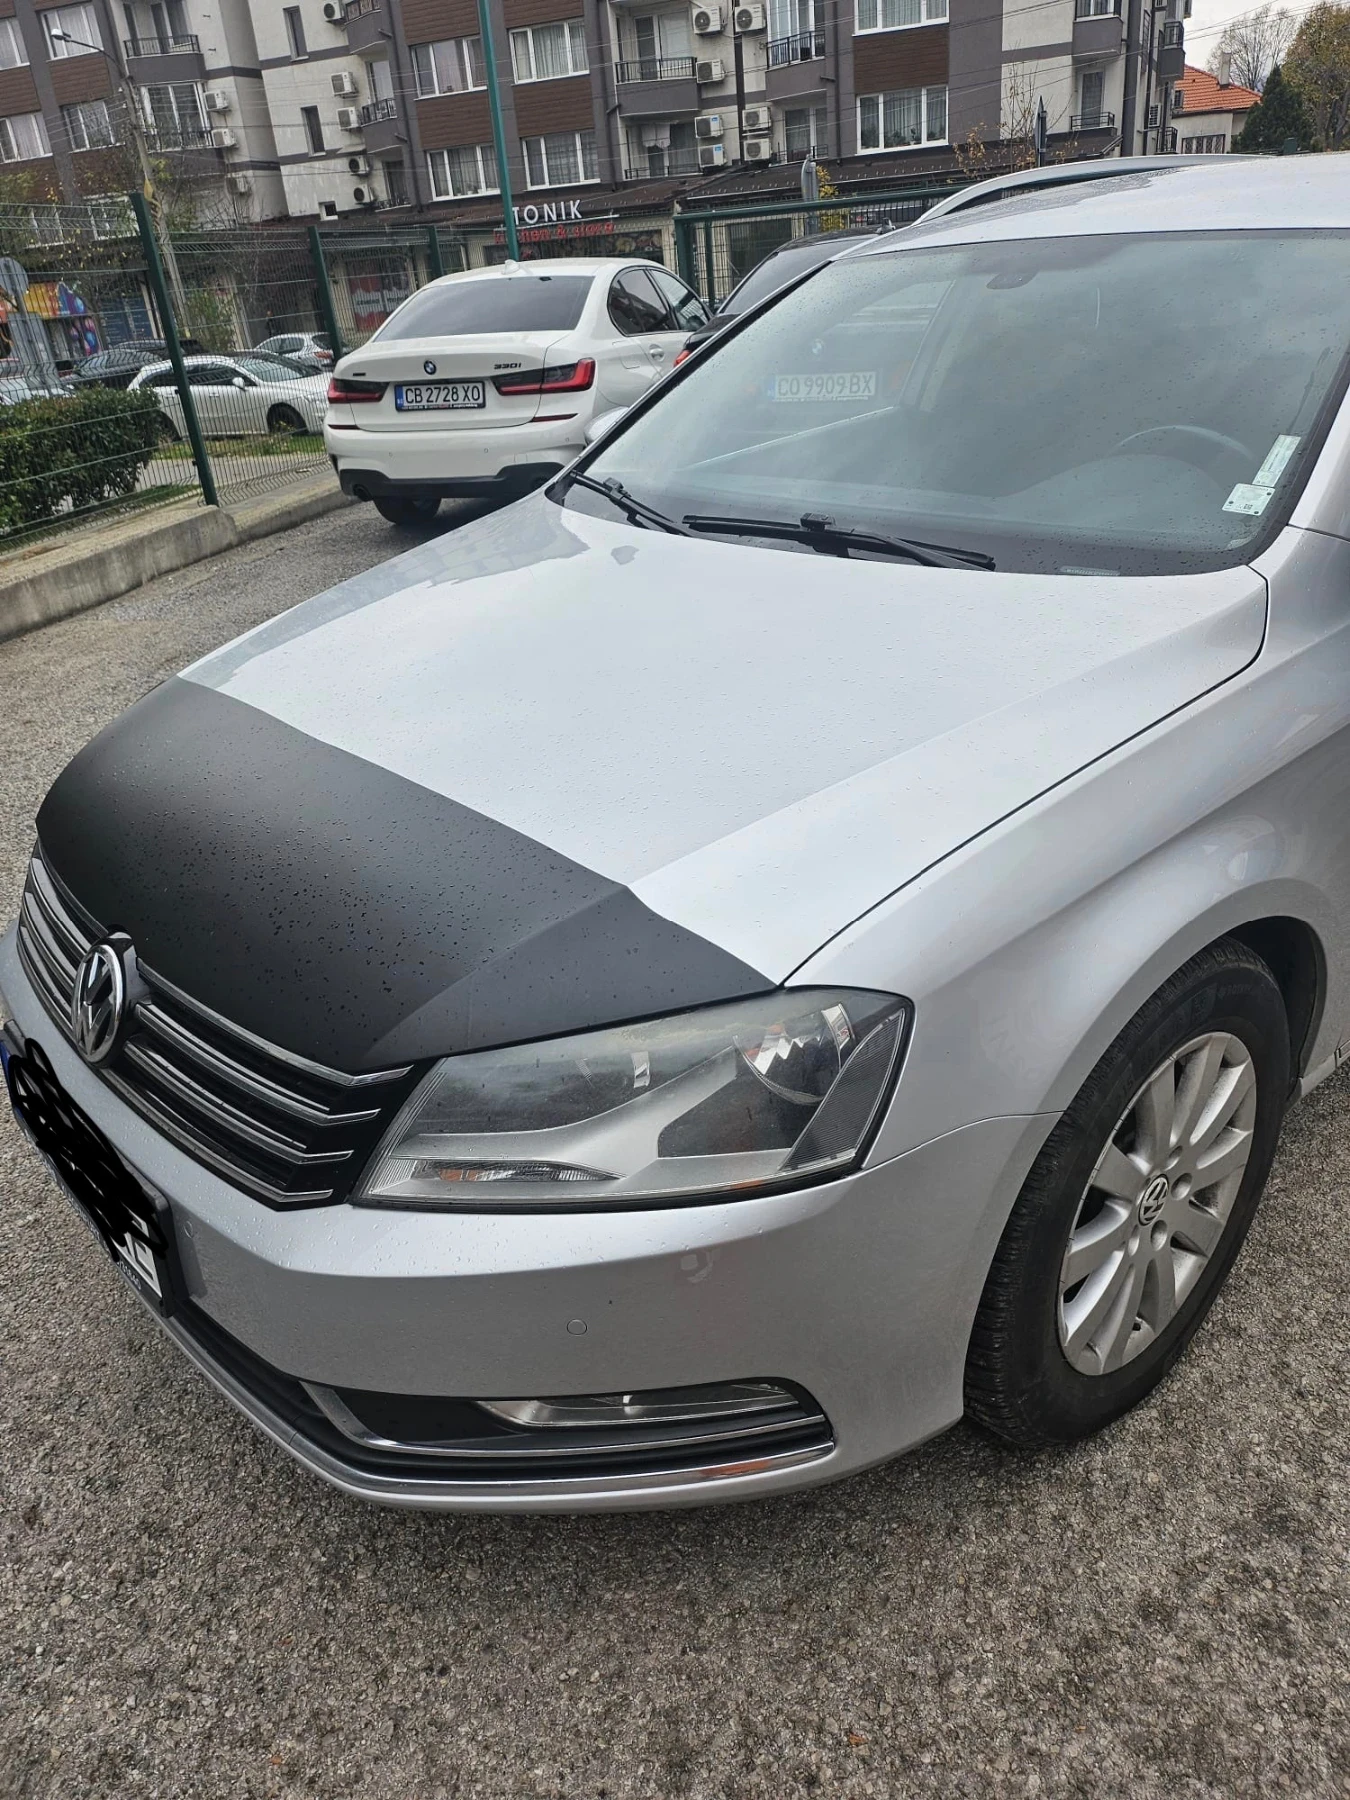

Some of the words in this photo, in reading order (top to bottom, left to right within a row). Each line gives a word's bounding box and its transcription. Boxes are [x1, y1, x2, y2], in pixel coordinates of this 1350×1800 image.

[512, 199, 583, 226] TONIK
[405, 387, 423, 404] CB
[426, 386, 459, 403] 2728
[778, 377, 800, 396] CO
[804, 375, 847, 396] 9909
[849, 373, 873, 394] BX
